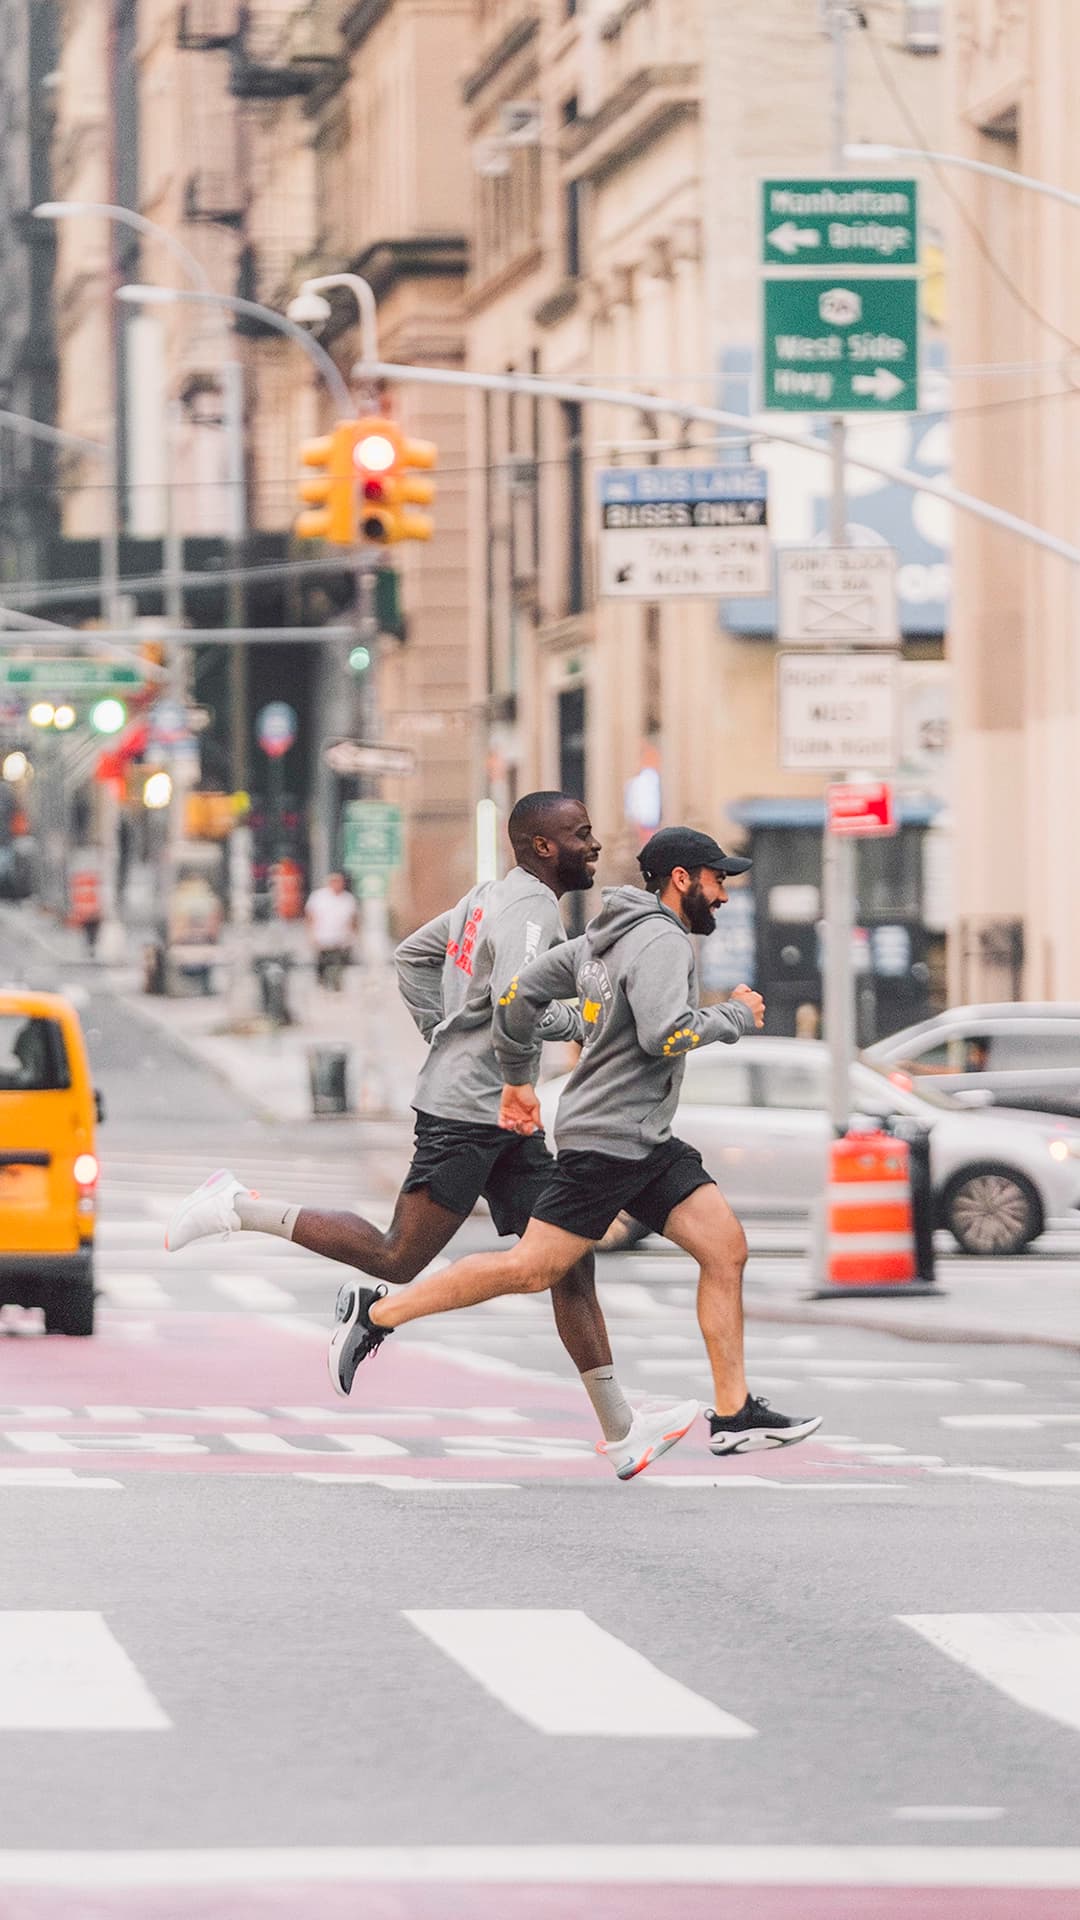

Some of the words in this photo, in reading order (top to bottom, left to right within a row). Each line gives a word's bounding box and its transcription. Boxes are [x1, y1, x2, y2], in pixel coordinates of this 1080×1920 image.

[771, 189, 911, 214] Manhattan
[827, 222, 910, 255] Bridge
[775, 334, 843, 360] West
[848, 332, 908, 361] Side
[774, 368, 833, 400] Hwy
[637, 471, 690, 498] BUS
[695, 469, 762, 497] LANE
[606, 503, 691, 528] BUSES
[693, 501, 763, 526] ONLY
[3, 1431, 600, 1457] BUS
